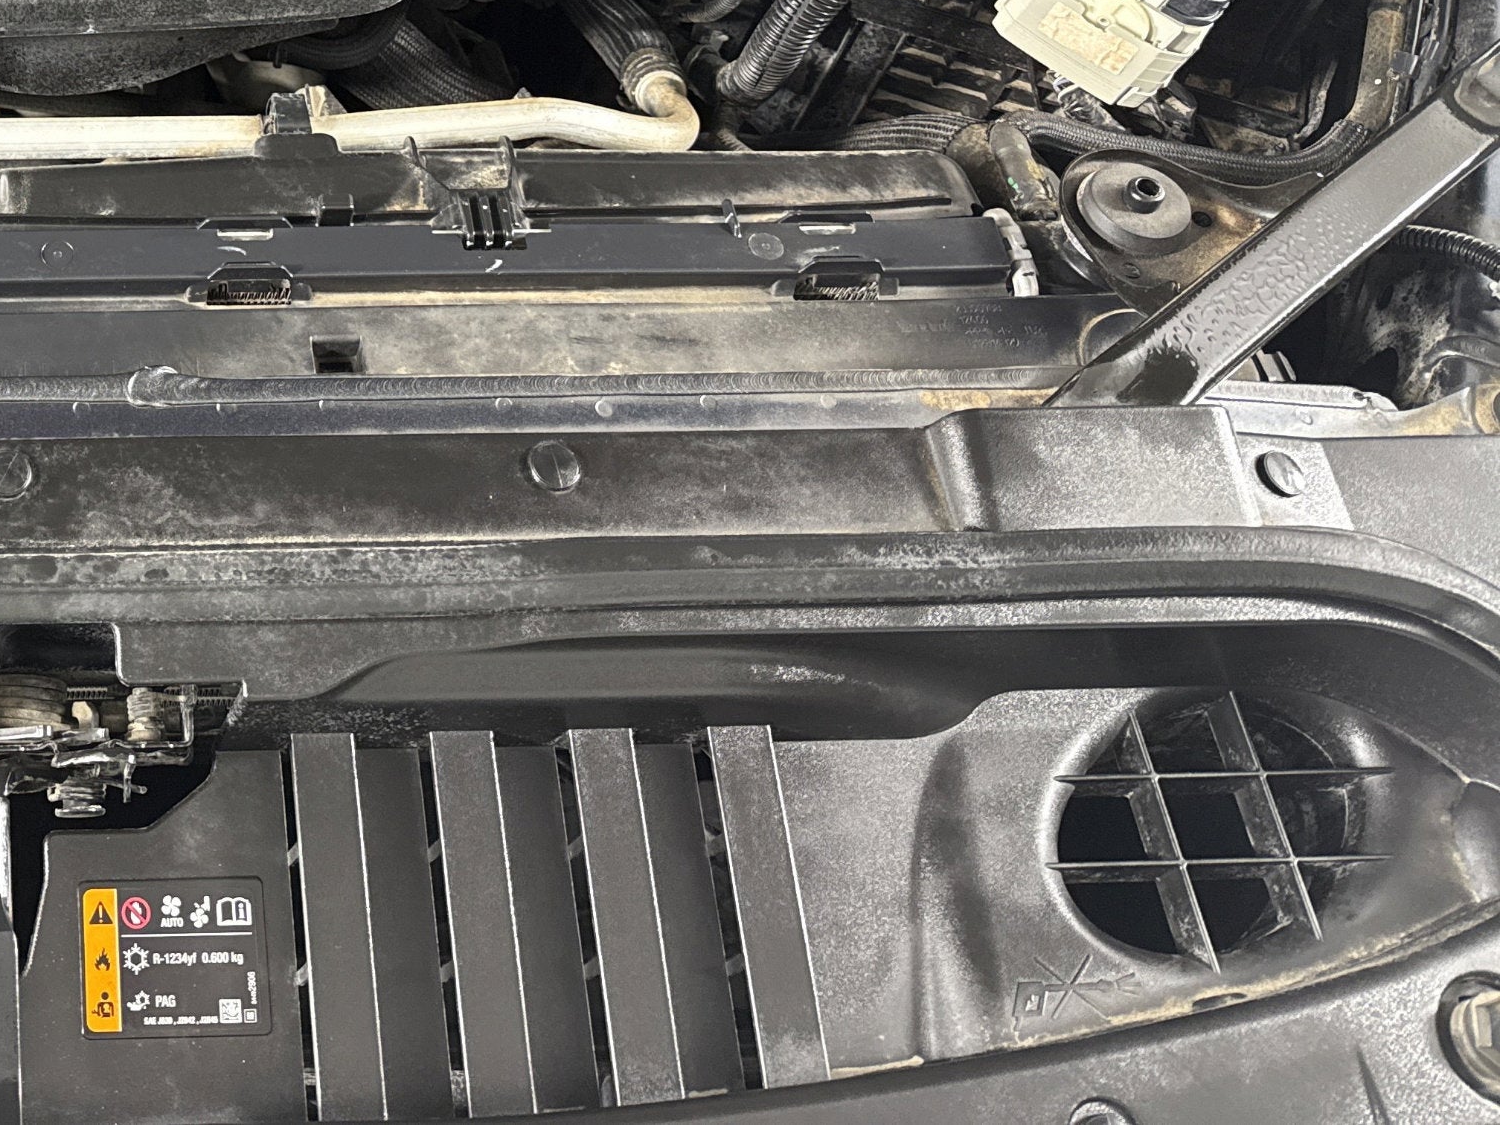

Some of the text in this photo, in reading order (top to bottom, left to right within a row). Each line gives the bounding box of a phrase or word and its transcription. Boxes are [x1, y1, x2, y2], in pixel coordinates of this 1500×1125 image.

[160, 917, 184, 928] AUTO
[152, 951, 244, 967] R-1234yf 0.600 kg
[155, 994, 177, 1008] PAG
